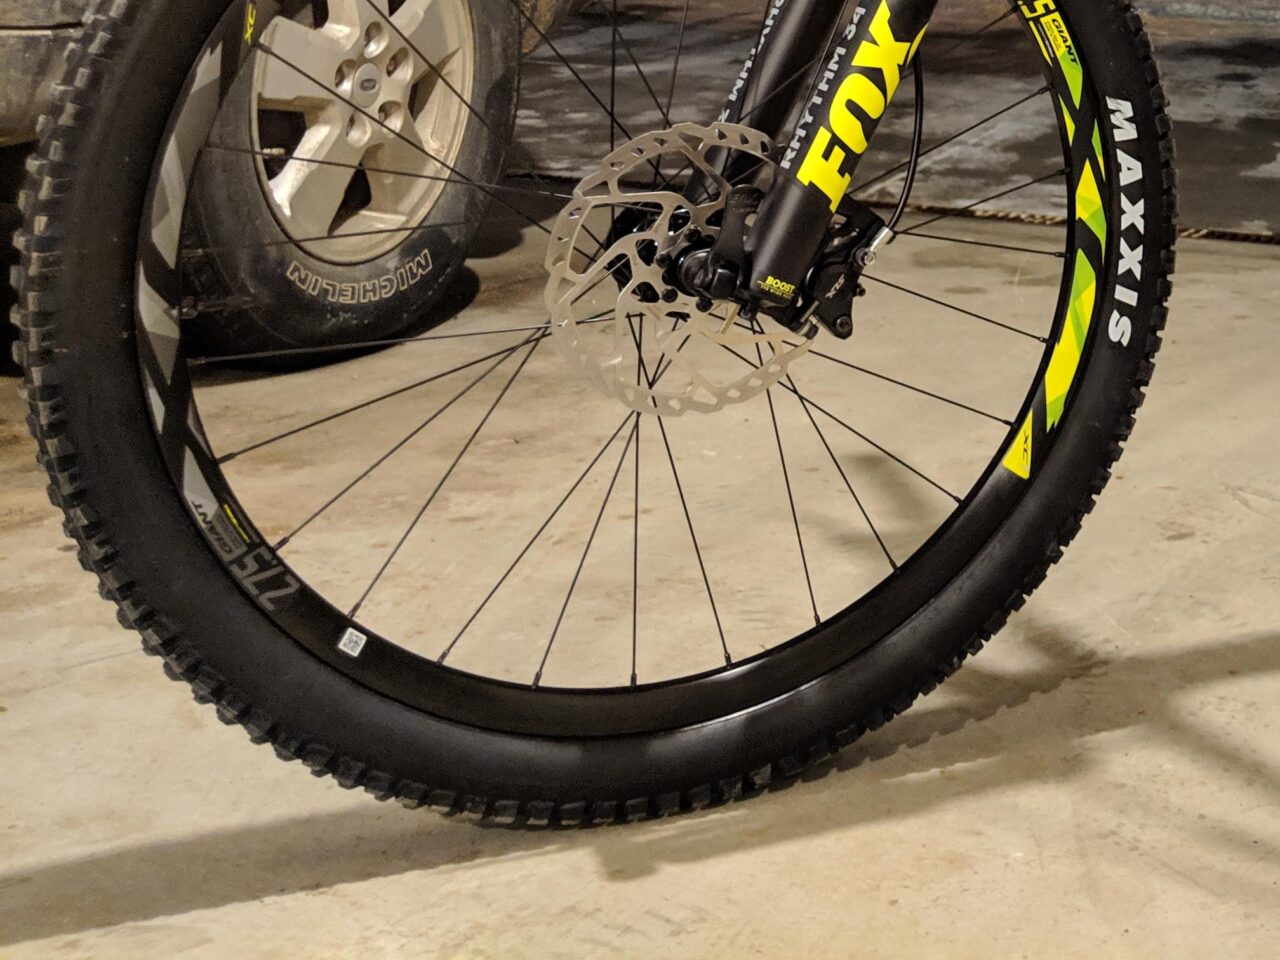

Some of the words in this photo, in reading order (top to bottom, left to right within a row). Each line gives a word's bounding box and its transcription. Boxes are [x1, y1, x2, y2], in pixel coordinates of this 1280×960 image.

[1051, 18, 1079, 66] GIANT
[779, 46, 847, 170] RHYTHM
[842, 6, 867, 41] 34
[1105, 95, 1145, 348] MAXXIS
[286, 248, 433, 305] MICHELIN
[765, 275, 796, 294] BOOST
